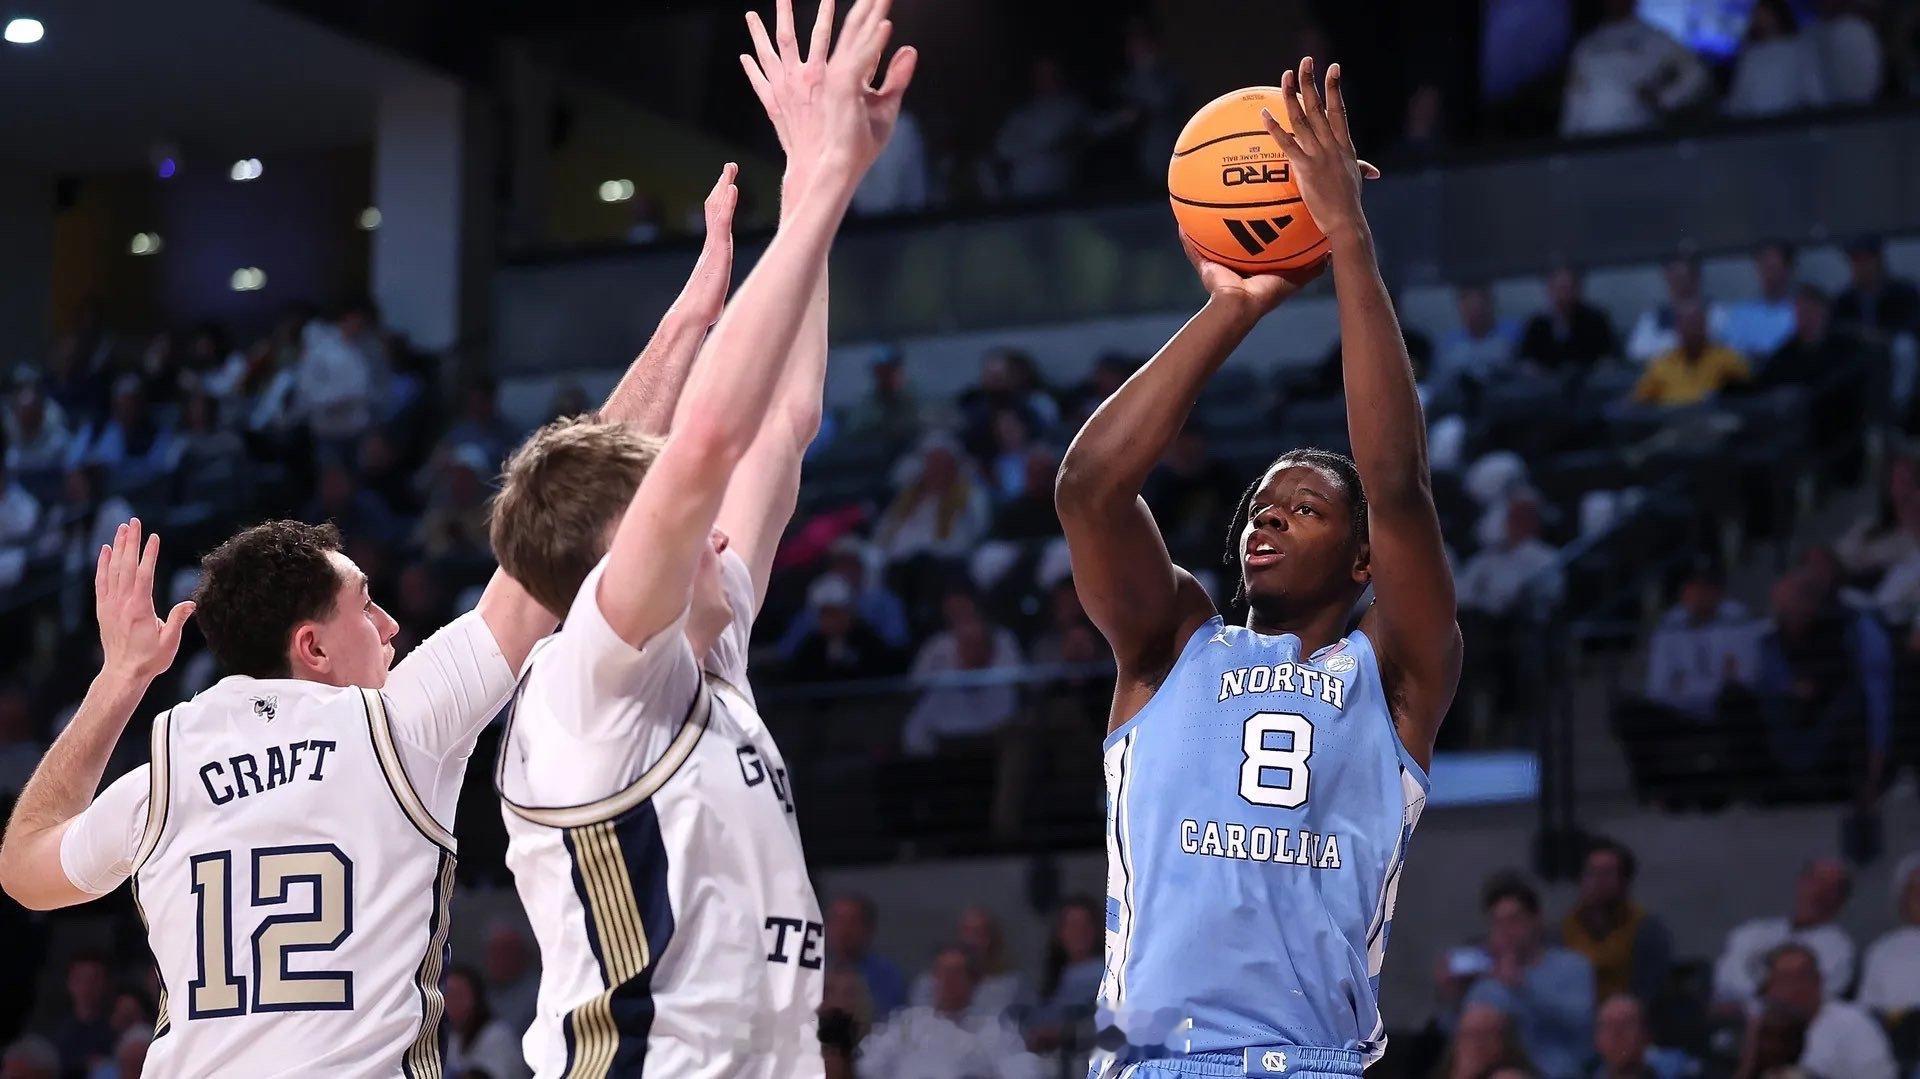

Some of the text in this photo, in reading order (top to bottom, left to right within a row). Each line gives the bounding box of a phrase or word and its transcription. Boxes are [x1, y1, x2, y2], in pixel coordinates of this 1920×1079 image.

[1222, 164, 1290, 187] PRO
[1218, 662, 1345, 711] NORTH
[199, 740, 336, 805] CRAFT
[1238, 711, 1315, 810] 8
[188, 843, 354, 1020] 12
